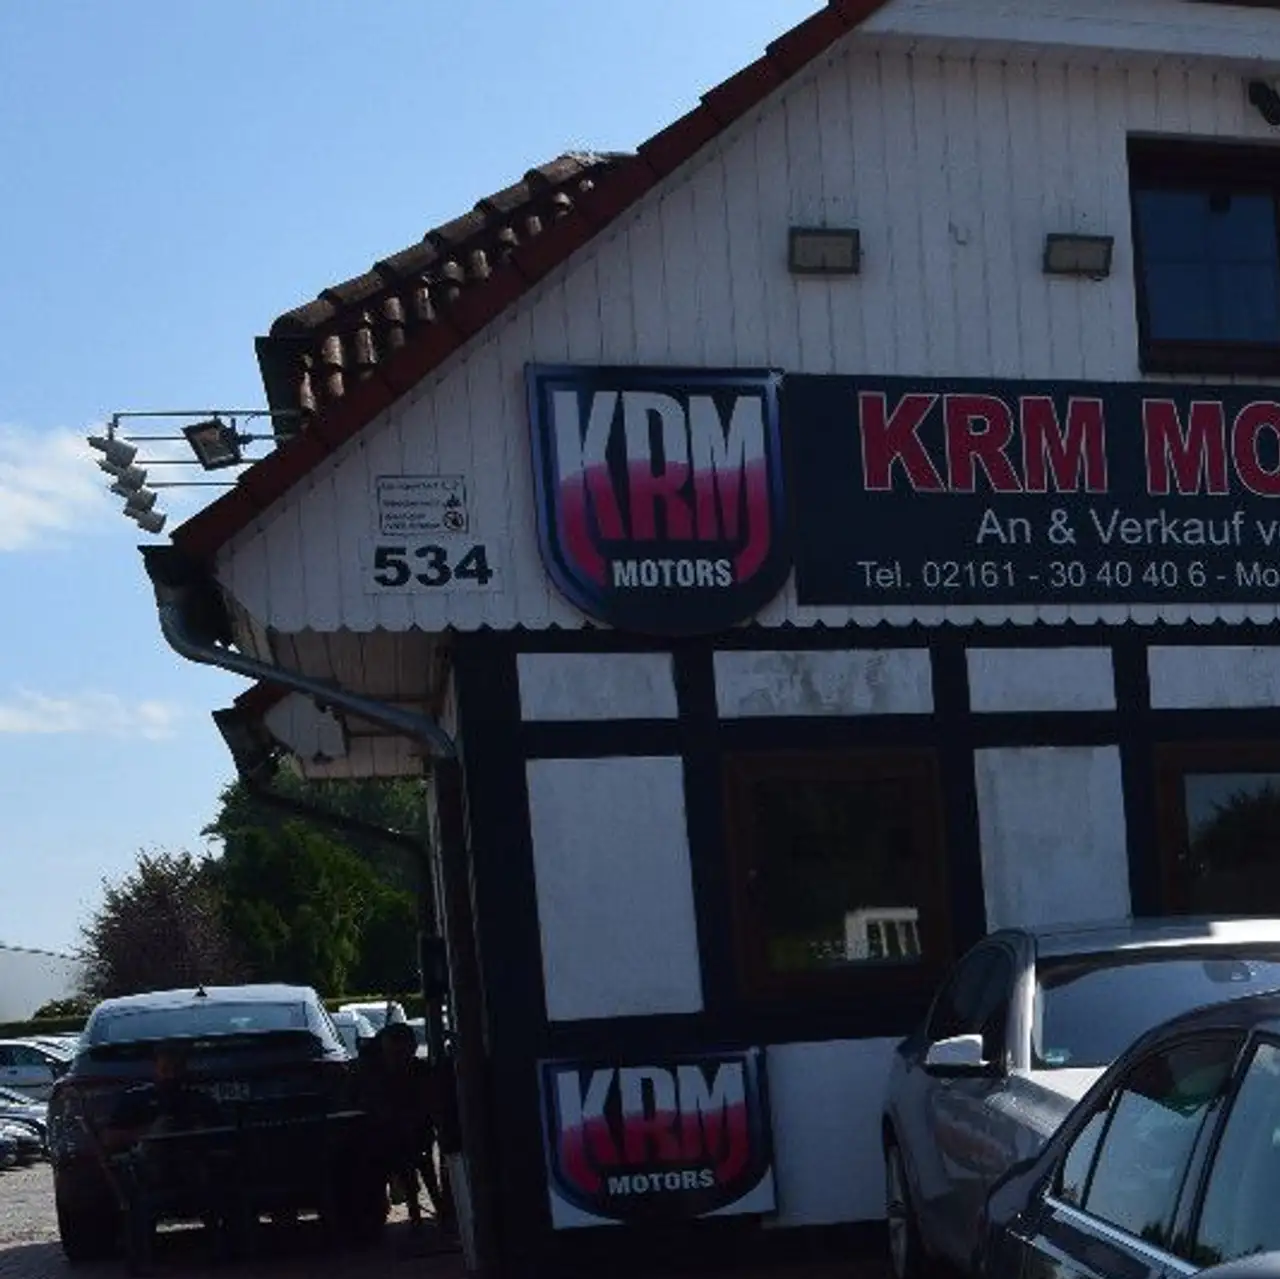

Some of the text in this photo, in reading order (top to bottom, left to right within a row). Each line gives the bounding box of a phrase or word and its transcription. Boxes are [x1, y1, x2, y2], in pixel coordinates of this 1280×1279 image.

[858, 390, 1108, 494] KRM
[553, 390, 770, 545] KRM
[976, 508, 1032, 545] An
[1048, 508, 1077, 546] &
[1089, 508, 1245, 546] Verkauf
[373, 543, 494, 588] 534
[611, 558, 733, 588] MOTORS
[857, 561, 912, 588] Tel.
[922, 561, 1015, 588] 02161
[1050, 561, 1086, 588] 30
[1096, 561, 1132, 588] 40
[1142, 562, 1178, 588] 40
[556, 1062, 749, 1166] KRM
[607, 1168, 716, 1197] MOTORS
